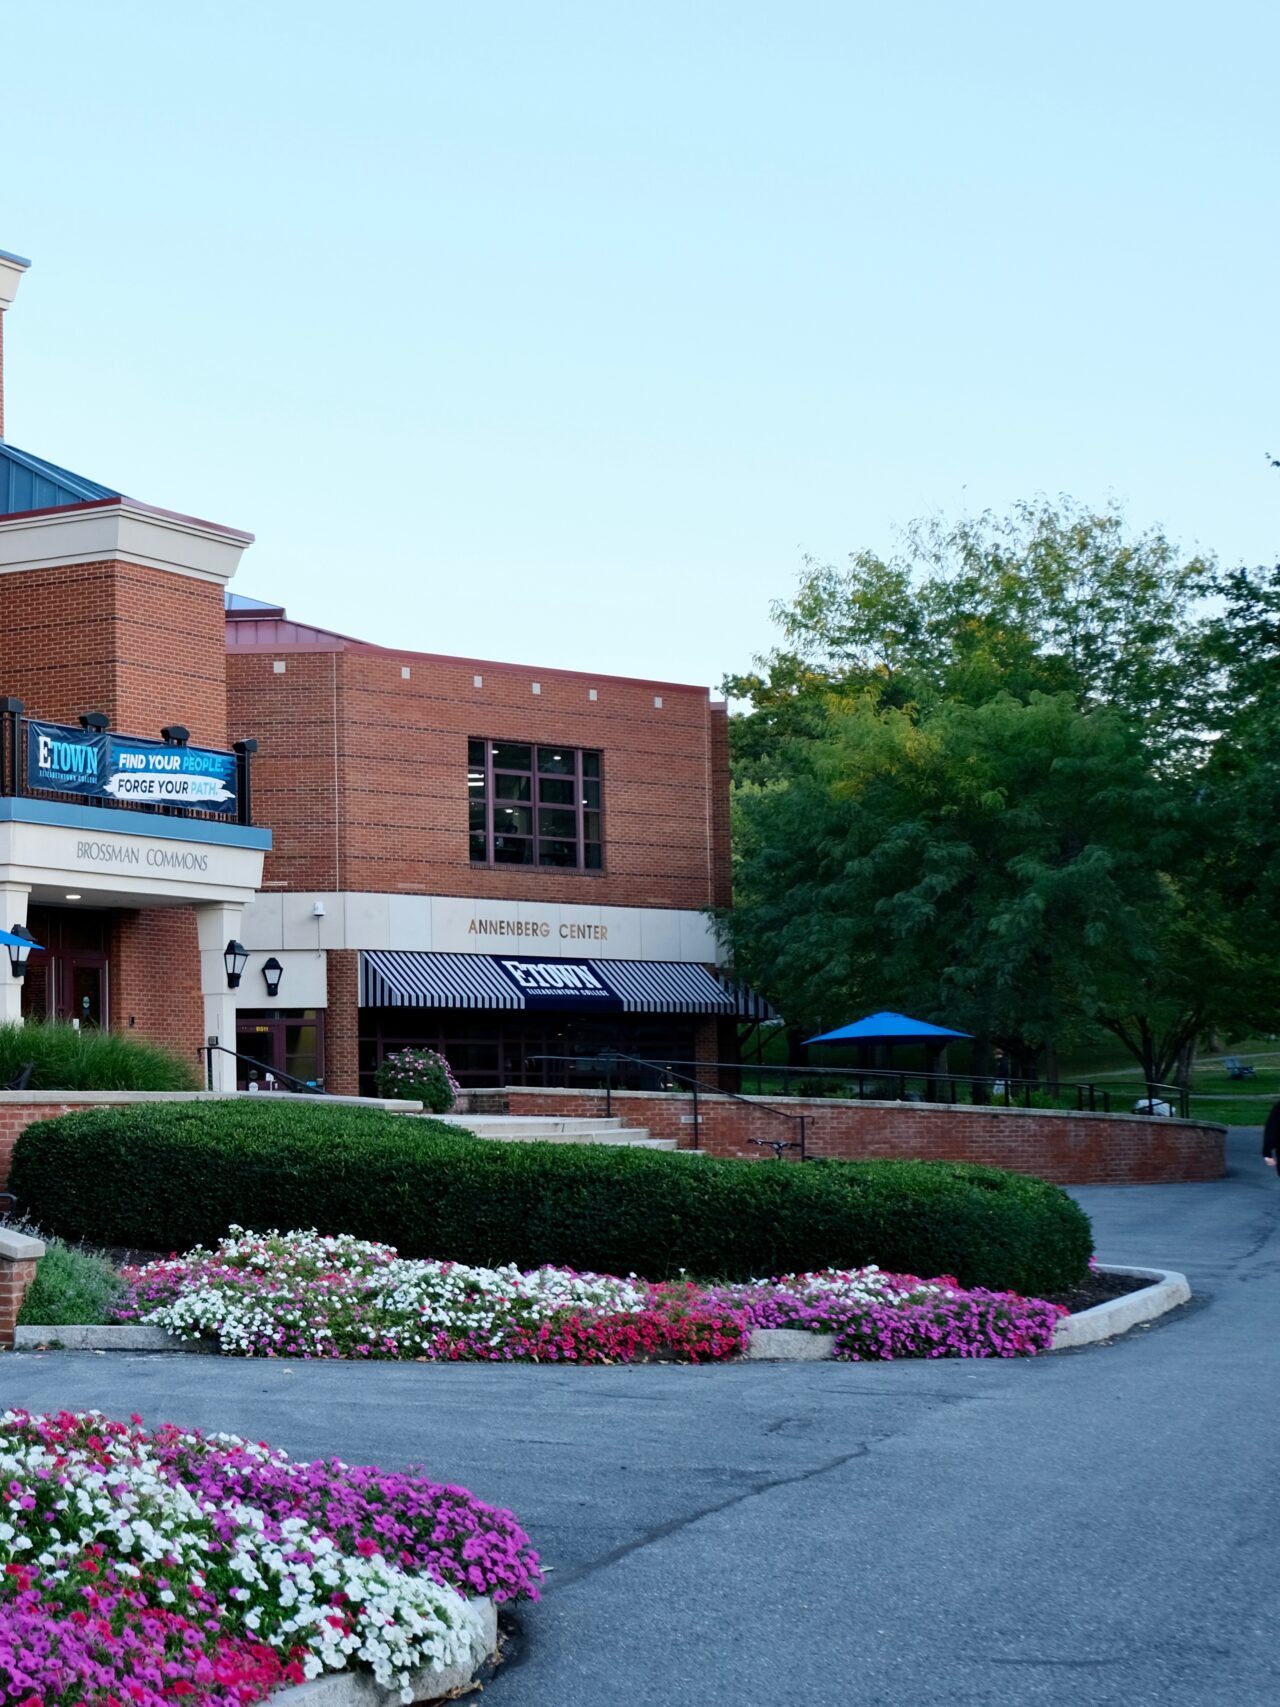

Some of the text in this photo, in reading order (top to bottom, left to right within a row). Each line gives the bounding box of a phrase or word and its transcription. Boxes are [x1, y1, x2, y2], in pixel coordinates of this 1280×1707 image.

[39, 736, 98, 774] ETOWN
[119, 754, 224, 772] FIND YOUR PEOPLE.
[118, 779, 218, 795] FORGE YOUR PATH.
[77, 841, 208, 871] BROSSMAN COMMONS
[468, 919, 608, 940] ANNENBERG CENTER
[501, 960, 602, 988] ETOWN
